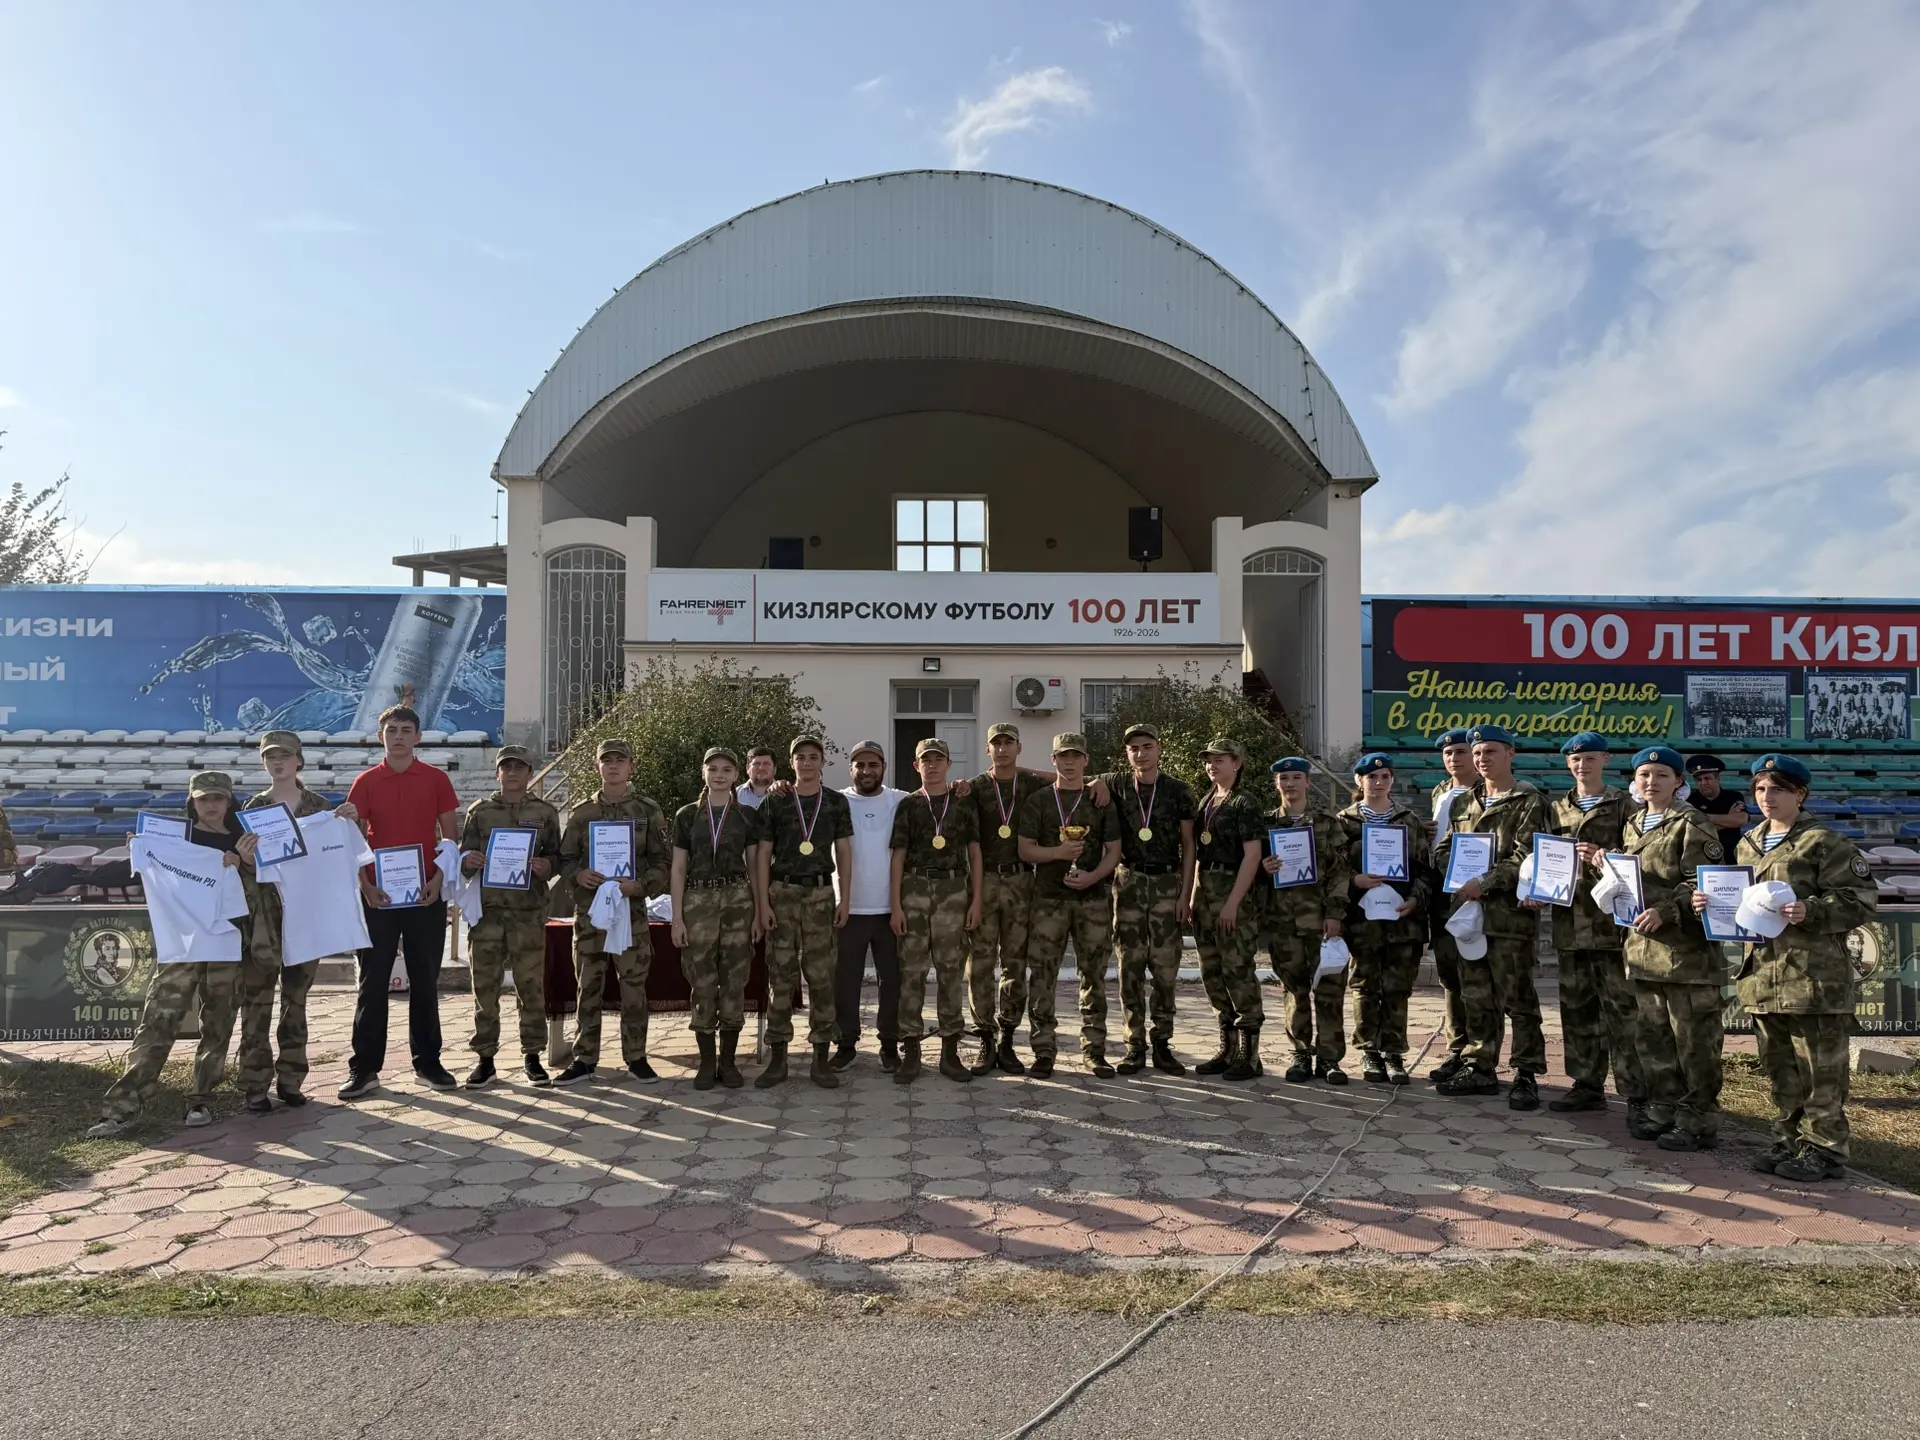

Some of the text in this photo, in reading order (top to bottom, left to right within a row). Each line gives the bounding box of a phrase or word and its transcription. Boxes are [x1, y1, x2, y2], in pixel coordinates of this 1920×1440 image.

[660, 600, 746, 609] FAHRENHEIT
[763, 598, 1202, 624] КИЗЛЯРСКОМУ ФУТБОЛУ 100 ЛЕТ
[1113, 628, 1160, 637] 1926-2026
[1523, 613, 1629, 660] 100
[1406, 669, 1661, 712] Наша история
[1387, 701, 1674, 738] в фотографиях!
[203, 876, 217, 888] РД
[72, 1005, 140, 1022] 140 лет
